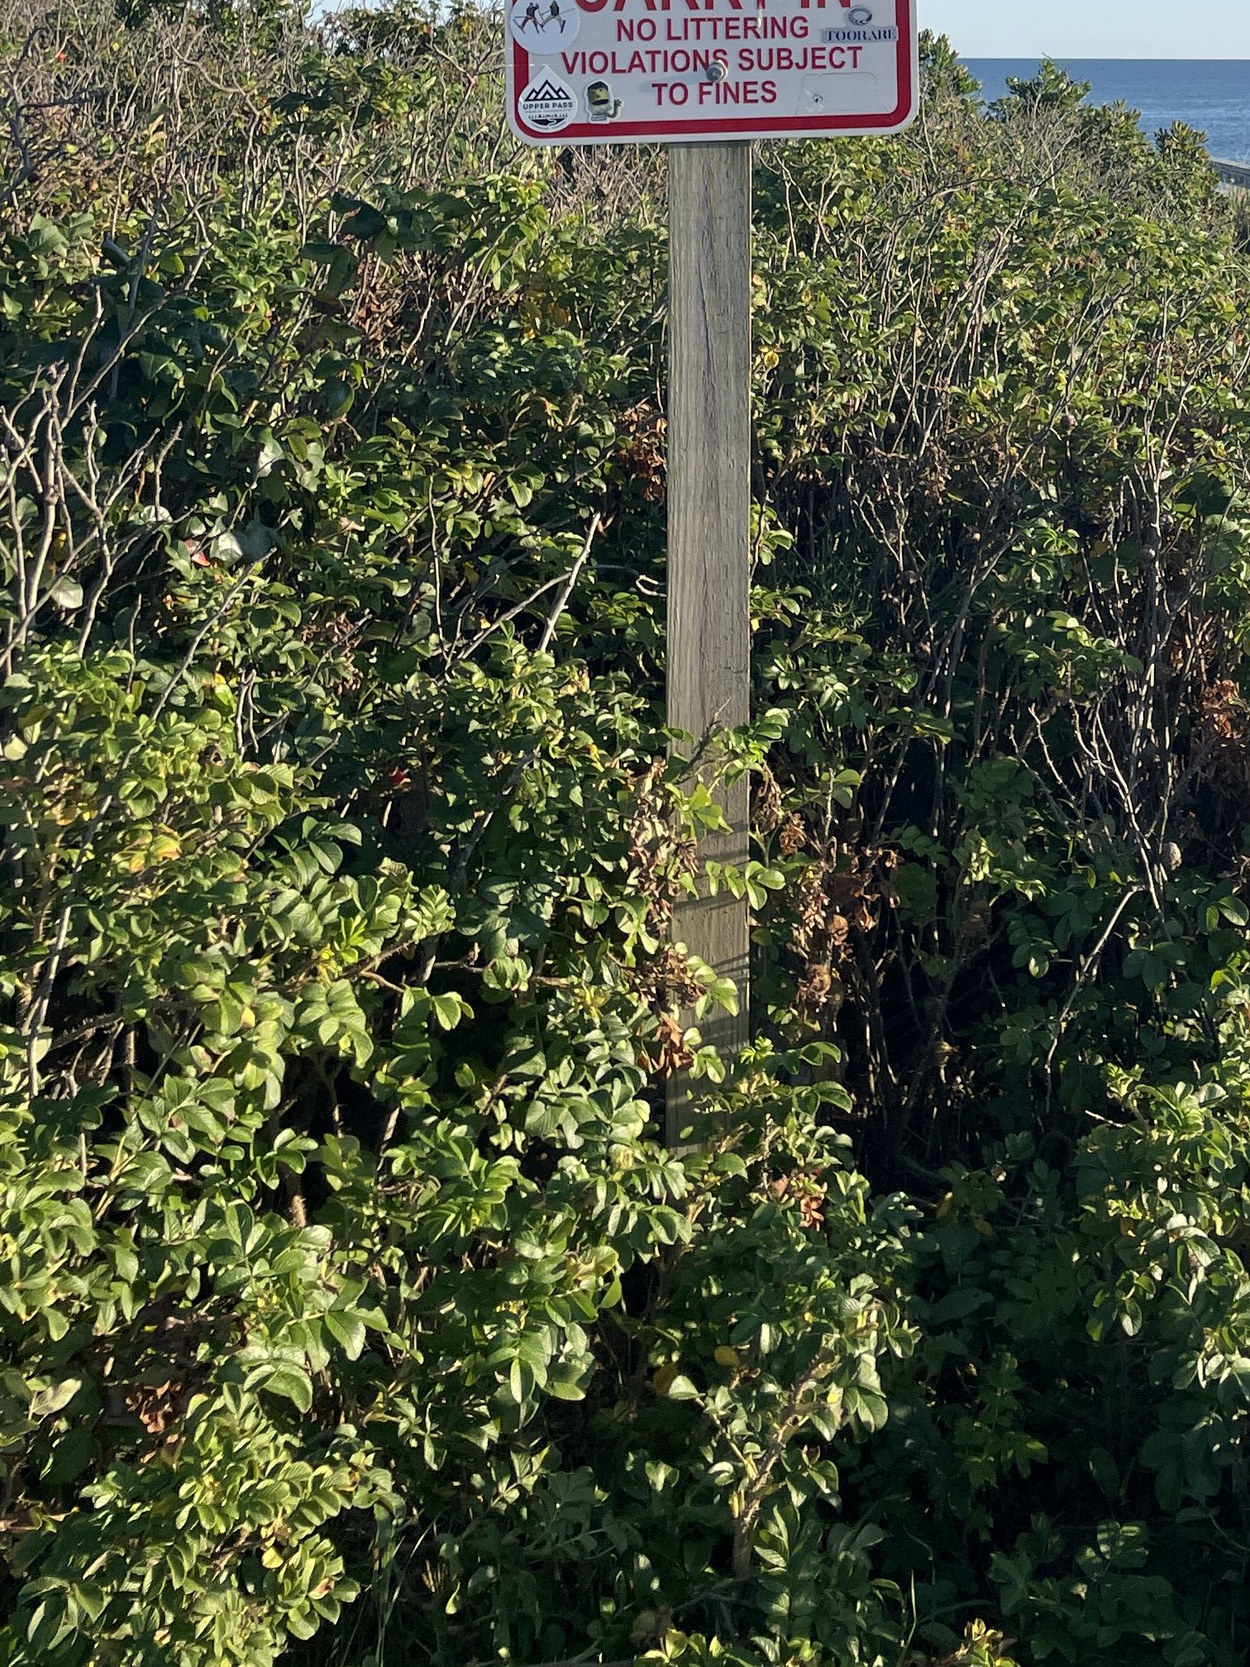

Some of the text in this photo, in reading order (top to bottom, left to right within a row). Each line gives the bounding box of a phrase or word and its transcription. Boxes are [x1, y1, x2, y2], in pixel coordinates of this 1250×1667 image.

[616, 16, 809, 42] NO LITTERING
[561, 45, 863, 75] VIOLATIONS SUBJECT
[522, 101, 573, 110] UPPER PASS
[651, 80, 778, 106] TO FINES
